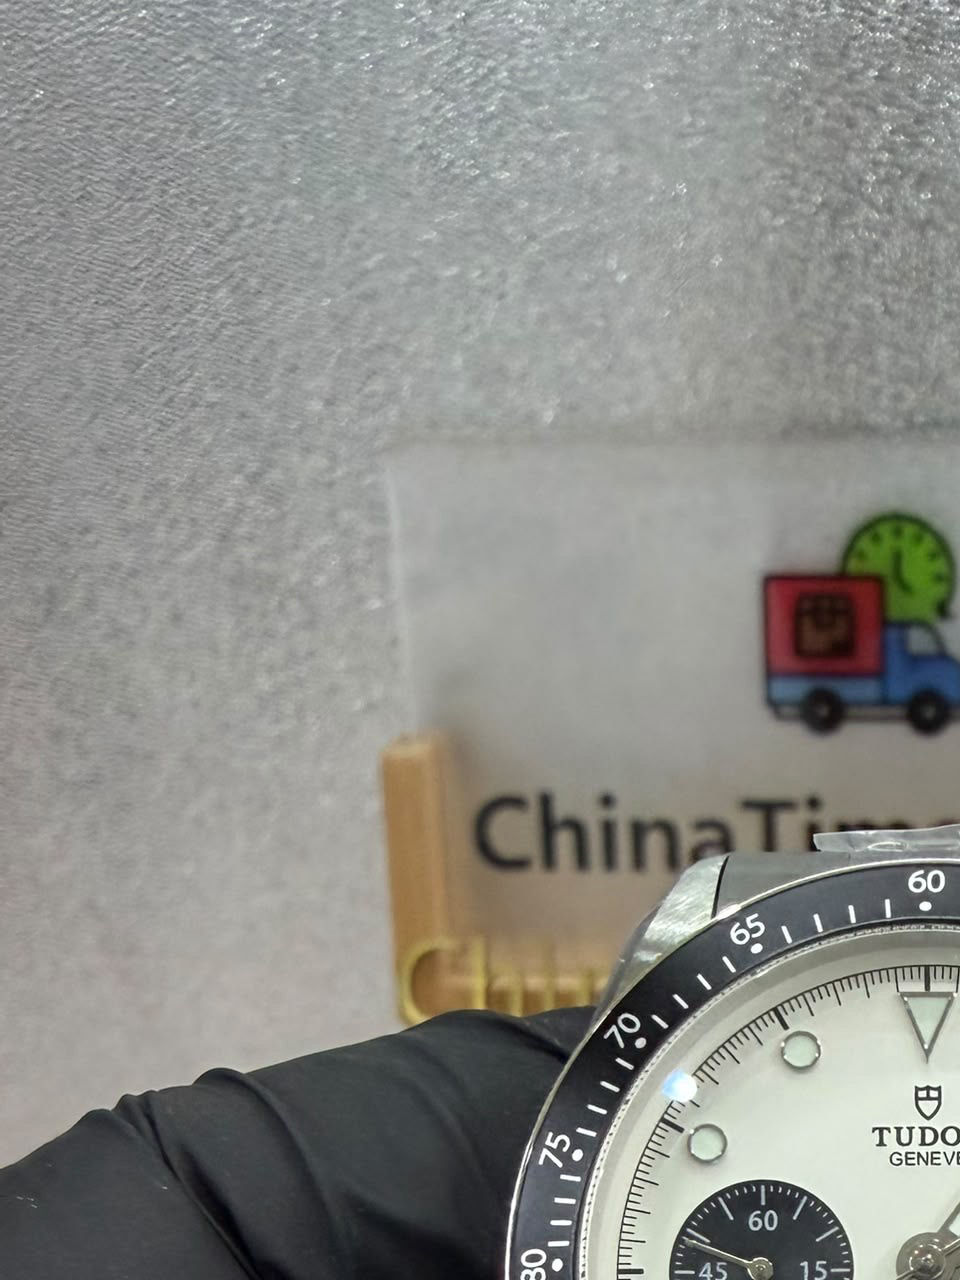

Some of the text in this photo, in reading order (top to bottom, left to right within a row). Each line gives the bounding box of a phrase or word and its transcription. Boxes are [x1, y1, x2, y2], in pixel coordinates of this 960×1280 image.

[908, 870, 945, 893] 60
[730, 913, 765, 945] 65
[603, 1012, 641, 1049] 70
[538, 1131, 571, 1169] 75
[748, 1210, 778, 1231] 60
[800, 1261, 827, 1280] 15
